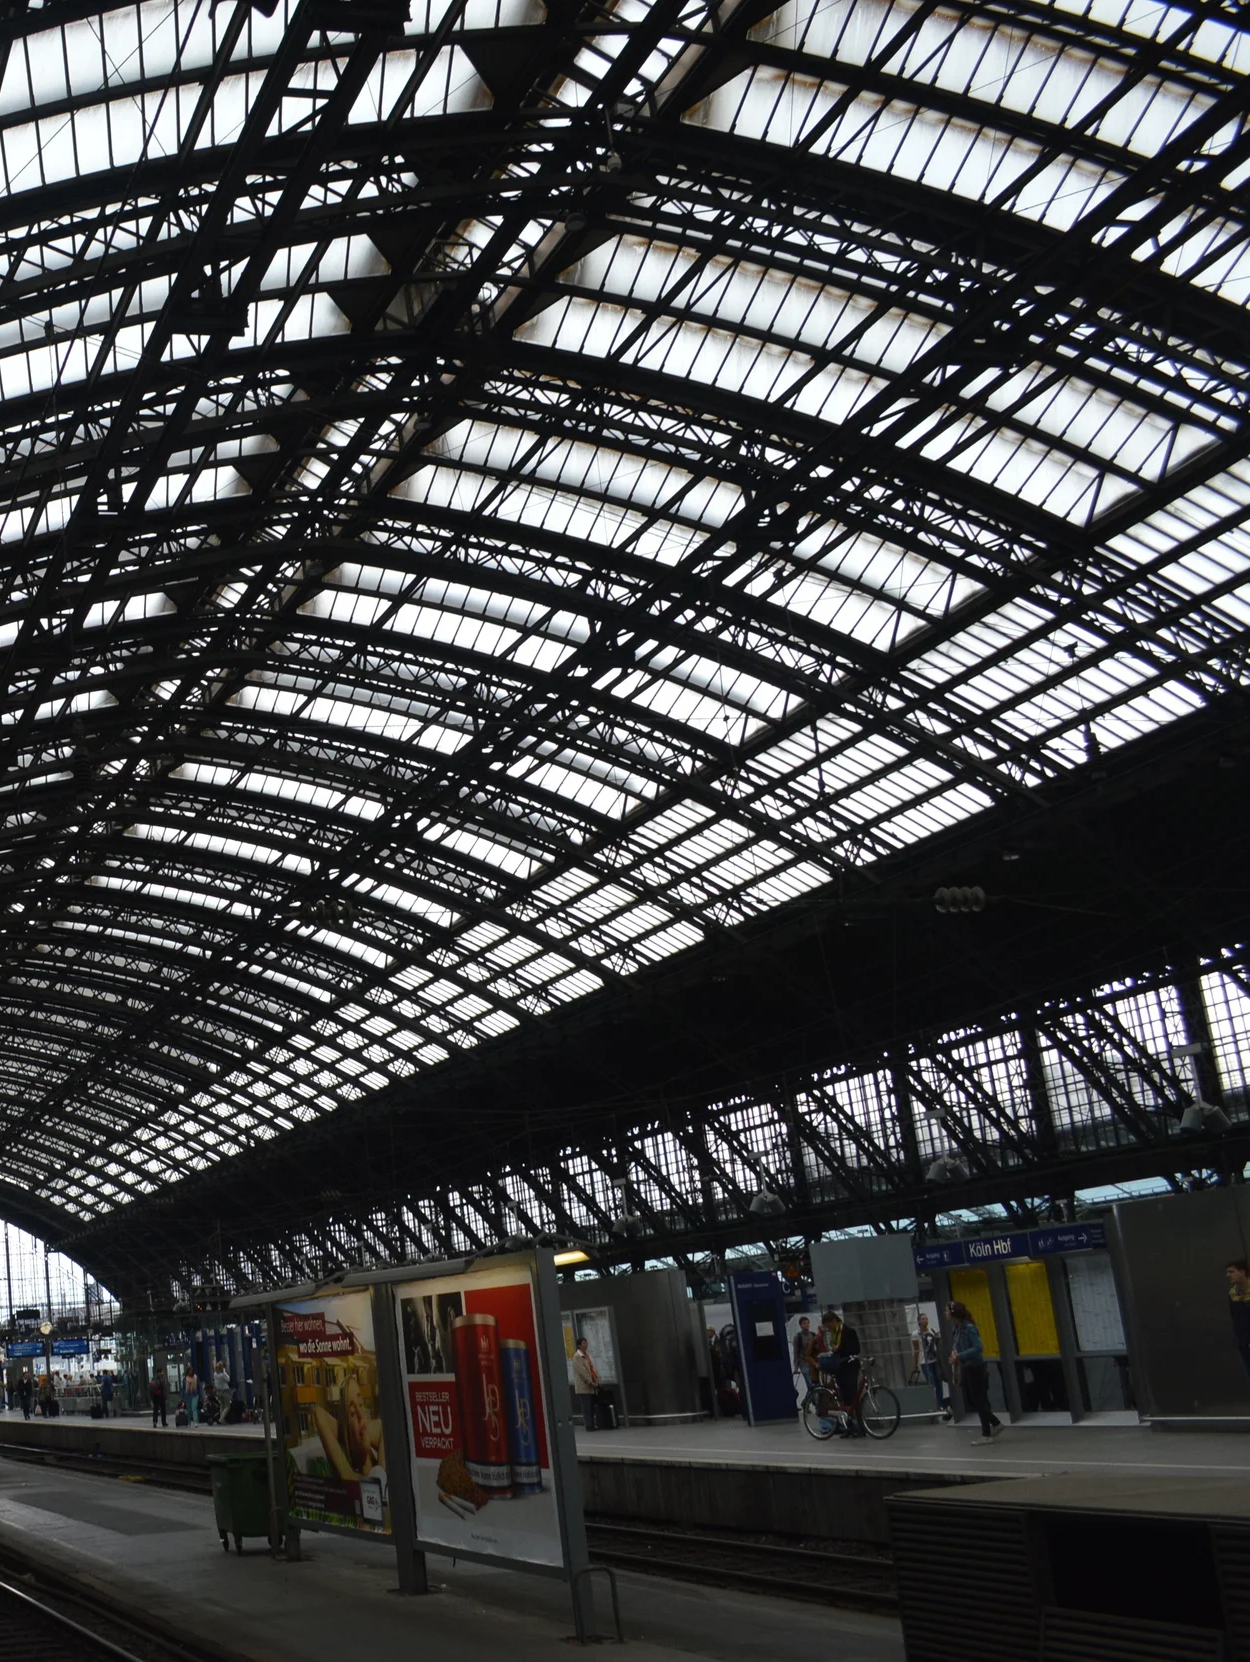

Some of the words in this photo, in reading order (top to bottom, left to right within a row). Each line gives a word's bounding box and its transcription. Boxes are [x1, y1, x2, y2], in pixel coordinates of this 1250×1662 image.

[968, 1241, 992, 1258] Köln
[994, 1237, 1012, 1255] Hbf
[782, 1280, 791, 1294] C
[299, 1342, 307, 1354] wo
[308, 1338, 316, 1353] die
[316, 1338, 332, 1353] Sonne
[415, 1391, 450, 1402] BESTSELLER
[416, 1404, 453, 1435] NEU
[420, 1436, 454, 1450] VERPACKT
